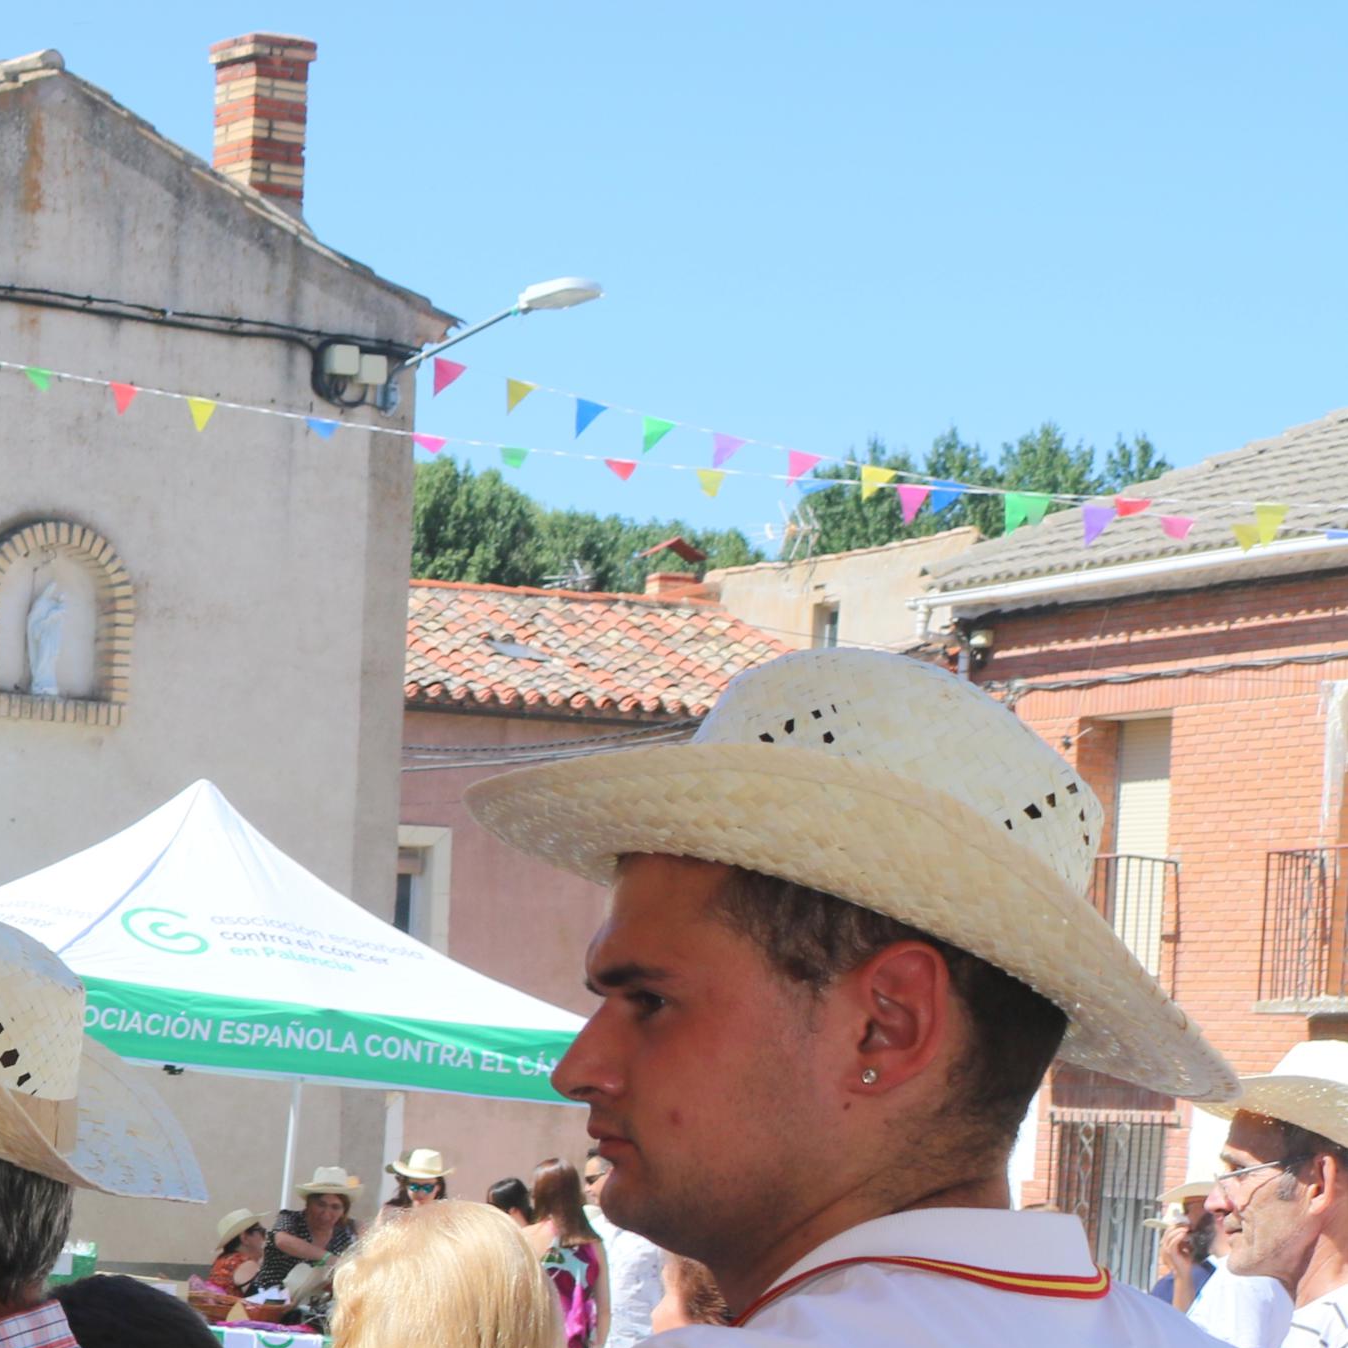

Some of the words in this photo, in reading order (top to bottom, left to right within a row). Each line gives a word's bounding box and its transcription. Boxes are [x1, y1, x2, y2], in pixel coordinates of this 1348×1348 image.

[219, 929, 292, 946] contra
[229, 945, 259, 957] en
[263, 945, 356, 973] Palencia
[217, 1019, 359, 1056] ESPAÑOLA
[363, 1033, 475, 1069] CONTRA
[479, 1050, 512, 1073] EL
